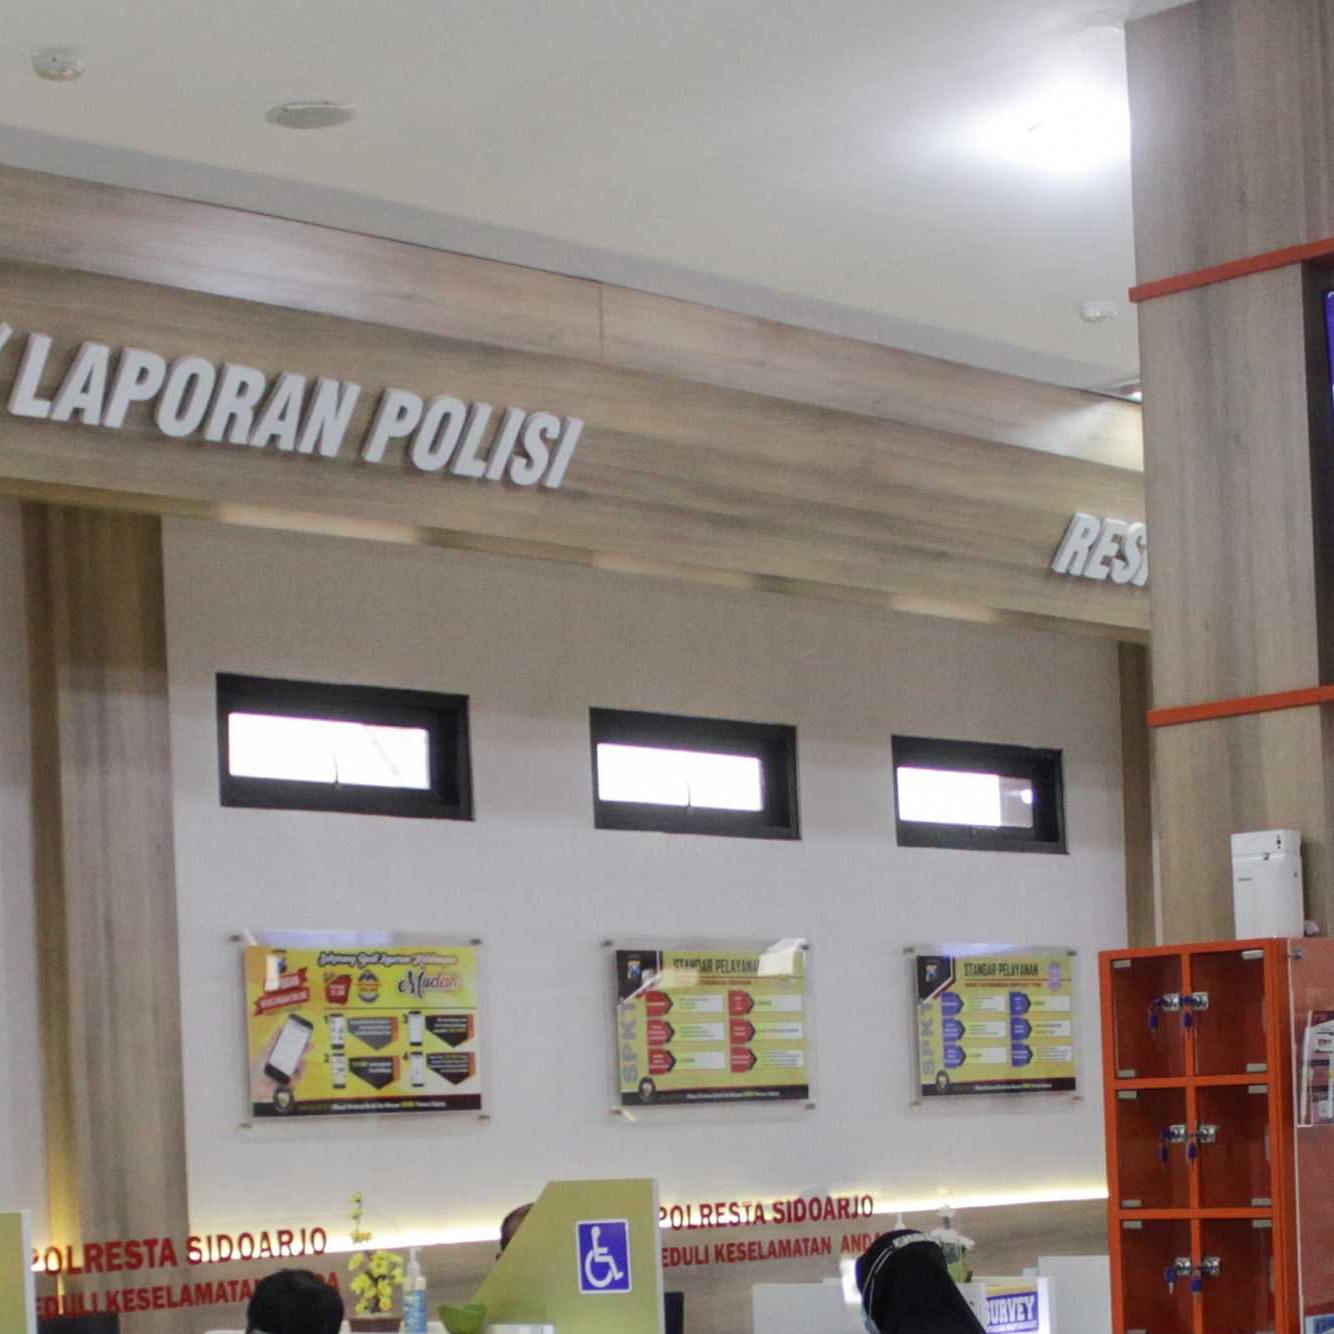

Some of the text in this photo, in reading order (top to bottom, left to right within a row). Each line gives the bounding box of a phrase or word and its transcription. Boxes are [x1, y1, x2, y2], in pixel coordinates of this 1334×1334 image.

[8, 333, 361, 459] LAPORAN
[362, 387, 584, 490] POLISI
[397, 969, 460, 999] Mudah
[772, 1193, 875, 1225] SIDOARJO
[186, 1227, 327, 1266] SIDOARJO
[661, 1232, 882, 1268] EDULI KESELAMATAN AND
